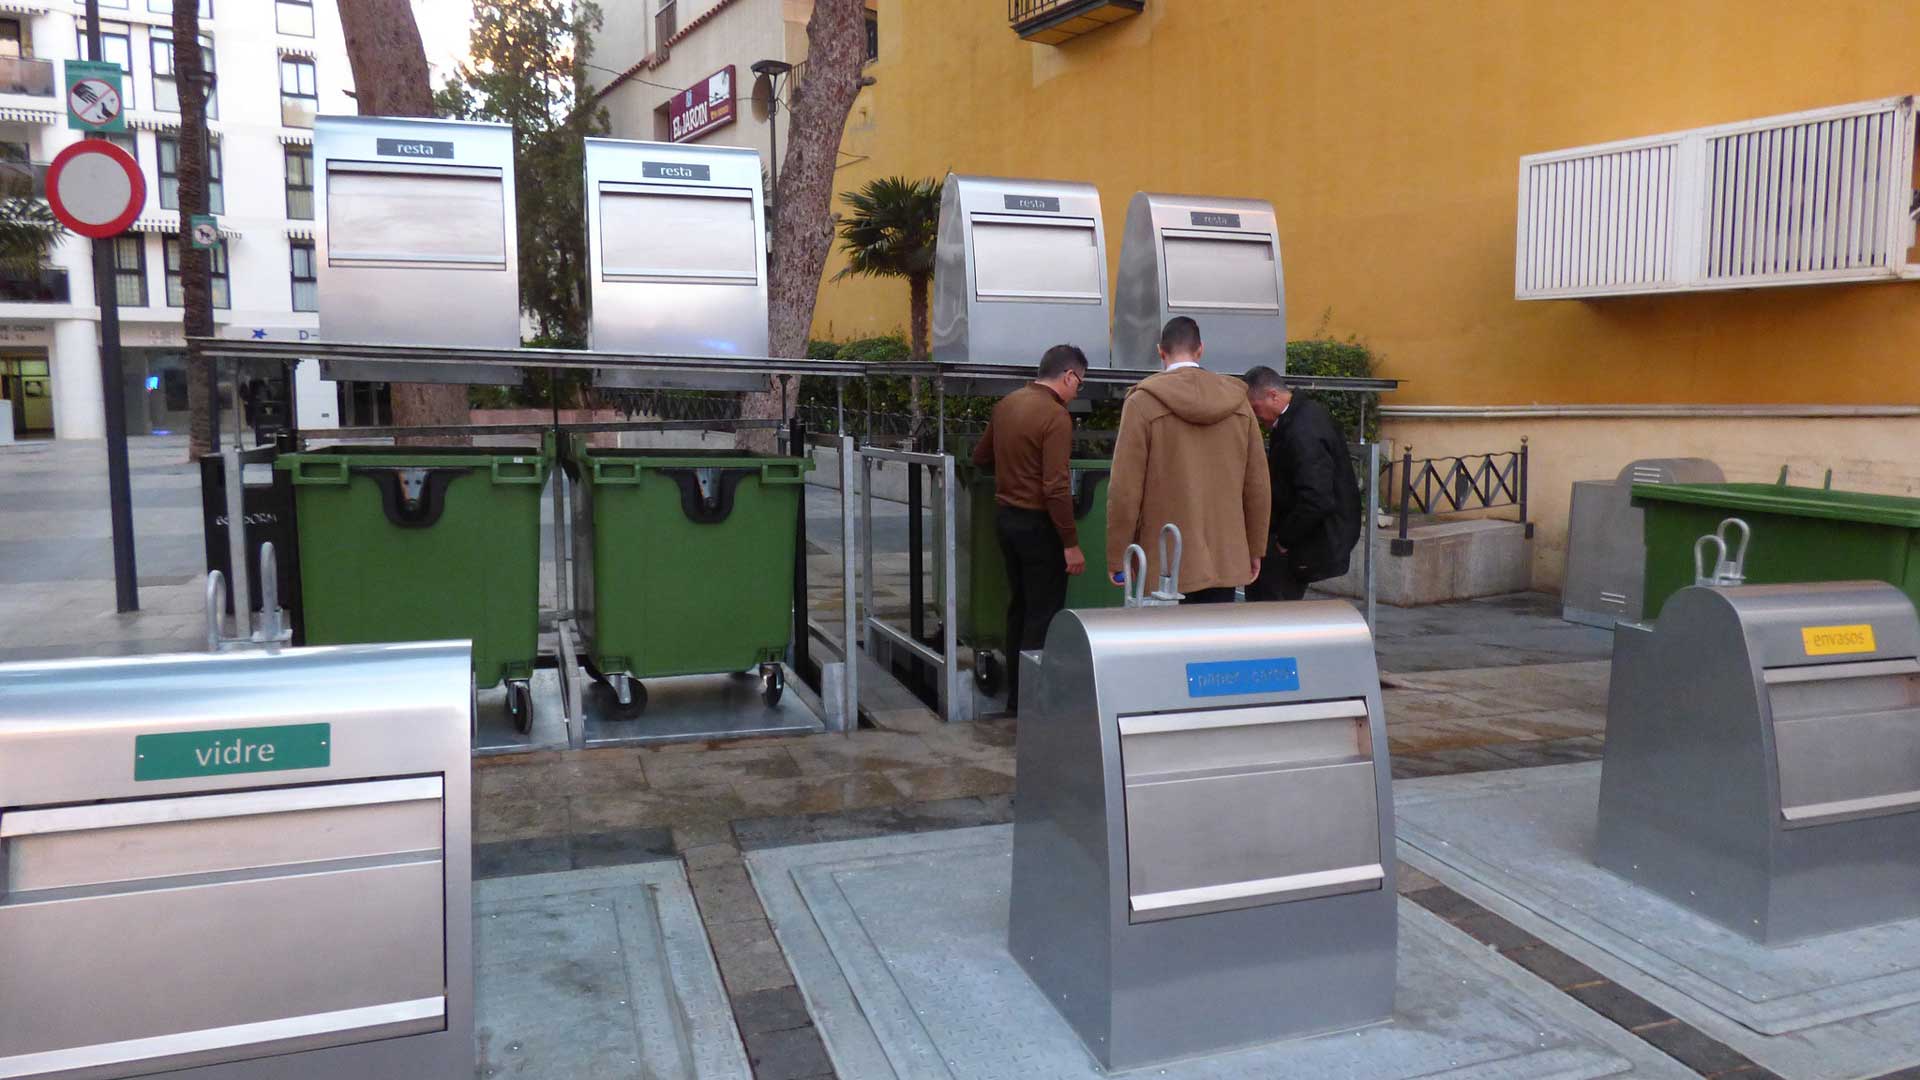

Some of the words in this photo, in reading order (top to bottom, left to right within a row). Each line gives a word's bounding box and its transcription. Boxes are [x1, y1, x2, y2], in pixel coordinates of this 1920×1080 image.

[397, 143, 433, 155] resta
[660, 167, 693, 177] resta
[1019, 199, 1046, 209] resta
[1203, 216, 1227, 225] resta
[1814, 631, 1865, 647] envasos
[195, 738, 275, 767] vidre
